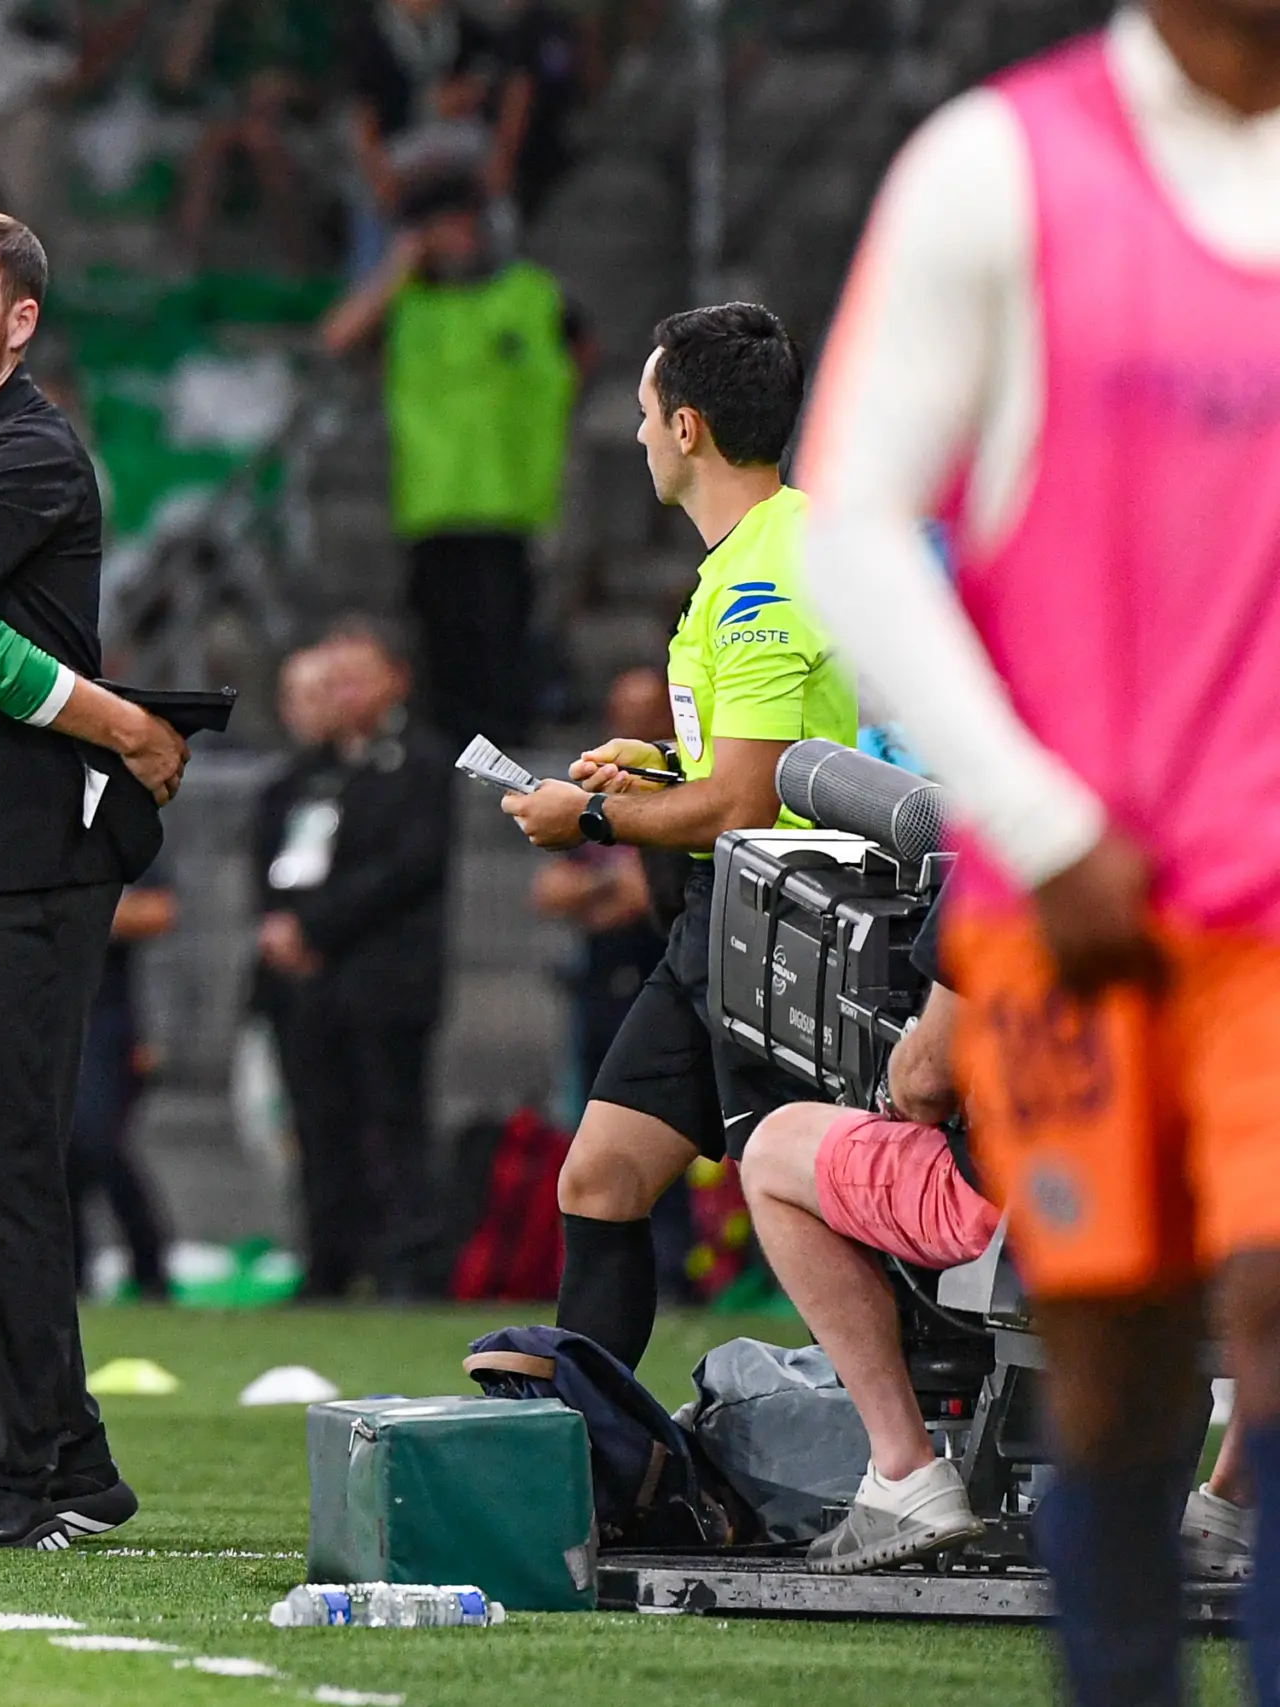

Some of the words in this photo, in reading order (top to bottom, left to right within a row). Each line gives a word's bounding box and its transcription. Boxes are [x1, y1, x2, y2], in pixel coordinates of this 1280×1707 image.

[731, 629, 790, 645] POSTE
[789, 1006, 816, 1035] DIGISUP
[824, 1026, 833, 1045] 95
